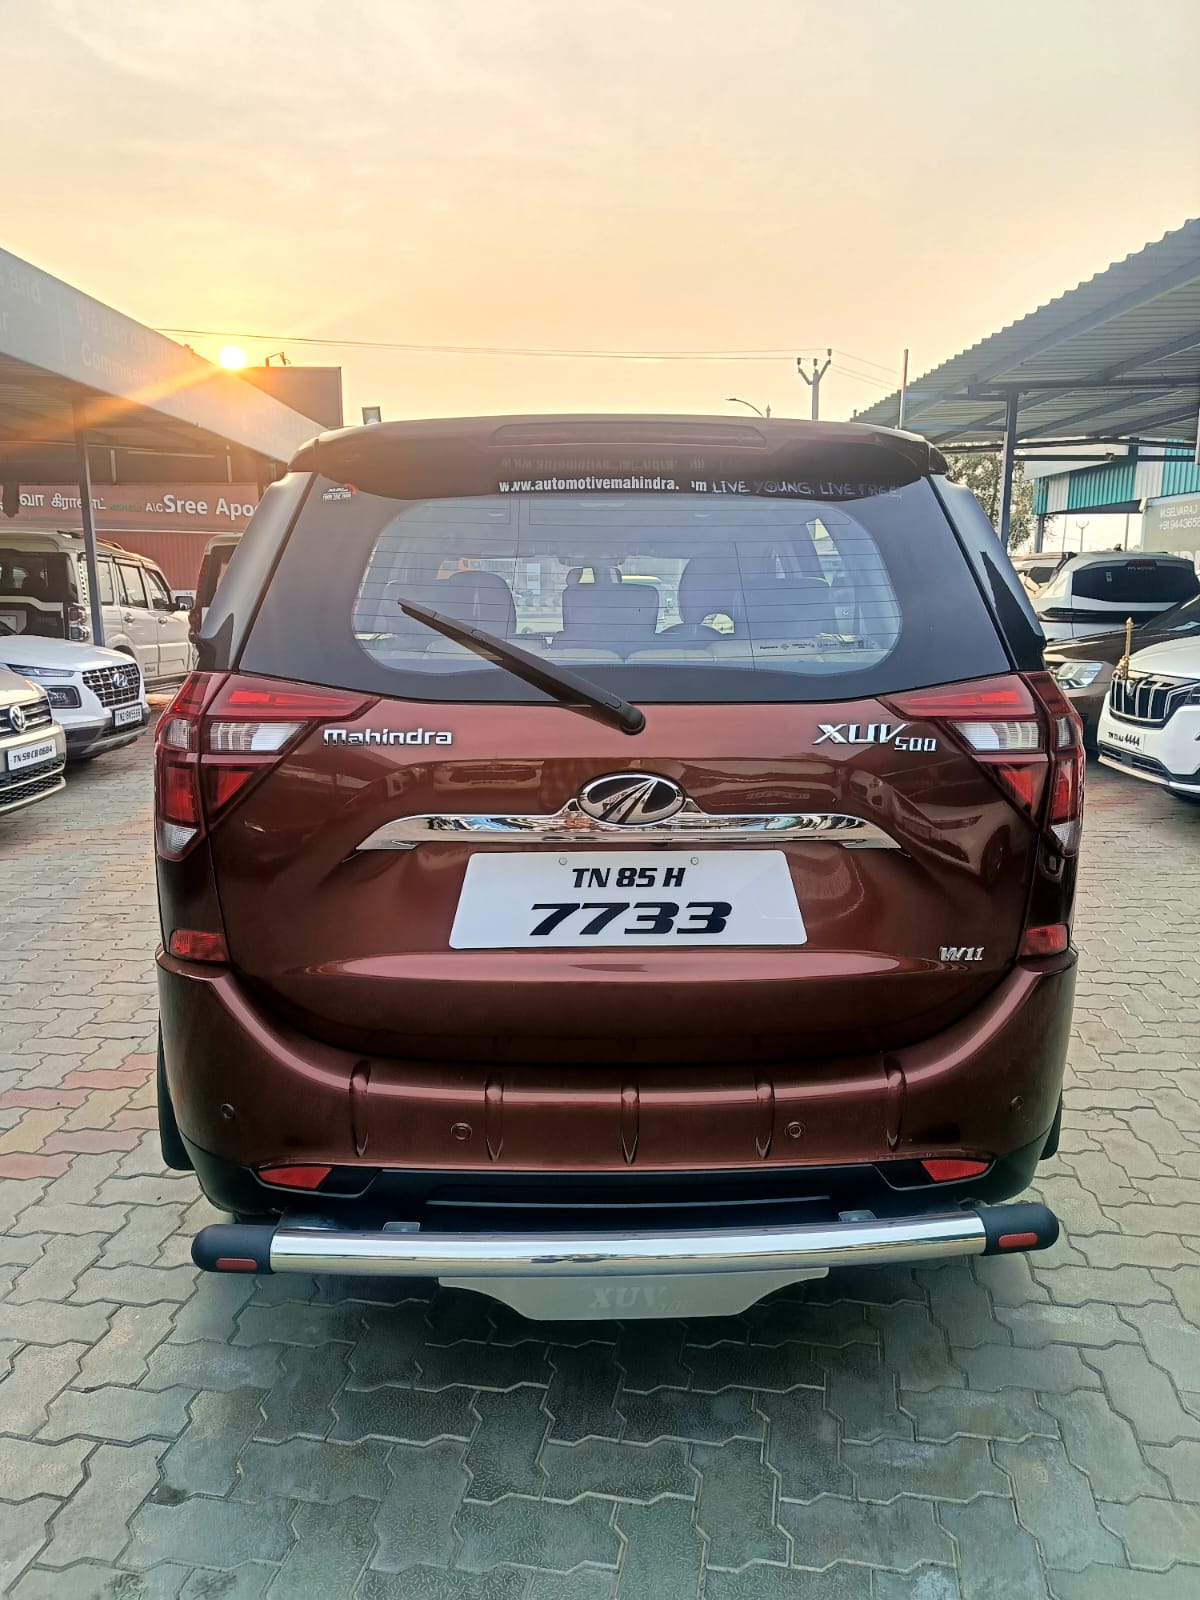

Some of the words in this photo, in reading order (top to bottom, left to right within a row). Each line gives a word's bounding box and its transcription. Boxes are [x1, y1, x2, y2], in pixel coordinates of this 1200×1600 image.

[712, 480, 749, 493] LIVE
[820, 482, 855, 494] LIVE
[163, 494, 208, 514] Sree
[572, 868, 611, 888] TN
[616, 867, 657, 888] 85
[662, 868, 686, 888] H
[529, 901, 733, 936] 7733
